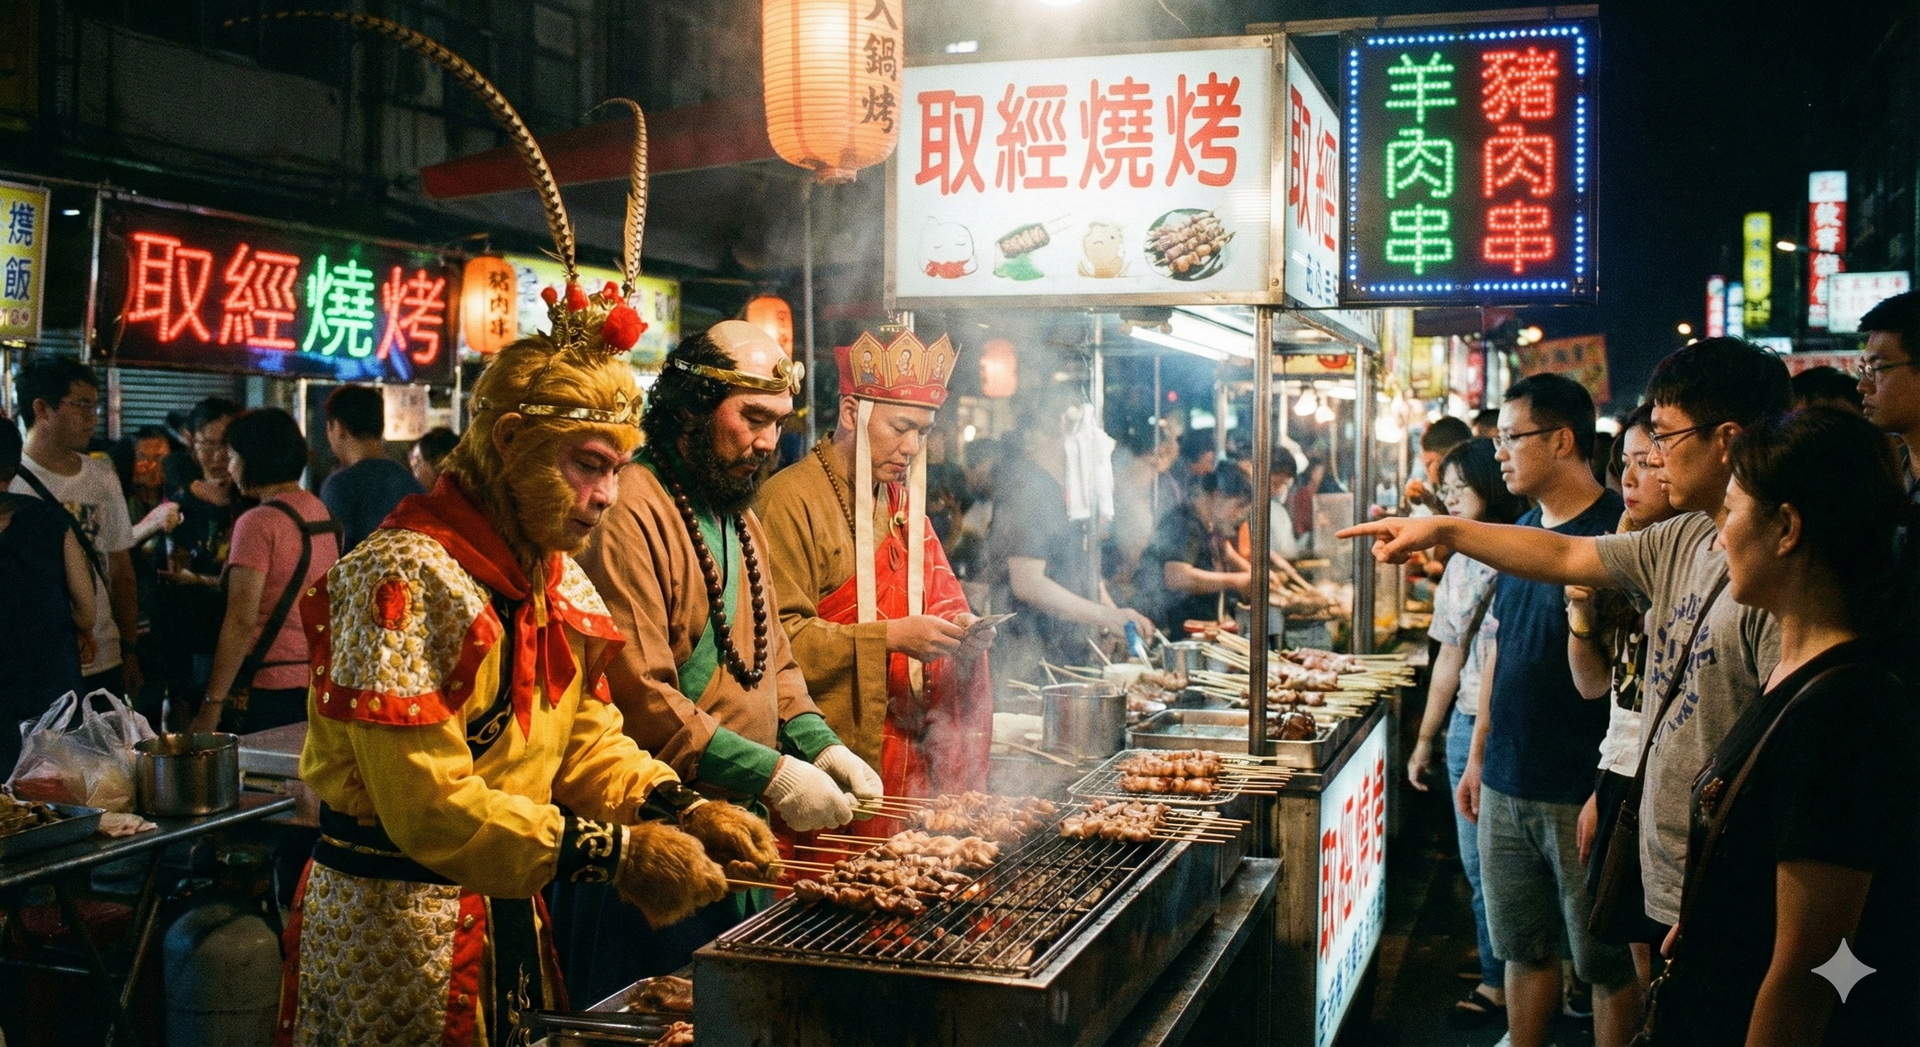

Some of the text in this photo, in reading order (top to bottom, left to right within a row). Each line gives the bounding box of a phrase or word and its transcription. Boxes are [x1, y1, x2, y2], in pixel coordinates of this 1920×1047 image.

[914, 71, 1242, 196] 取經燒烤
[1385, 51, 1457, 277] 羊肉串
[1480, 46, 1559, 274] 豬肉串
[126, 231, 447, 366] 取經燒烤
